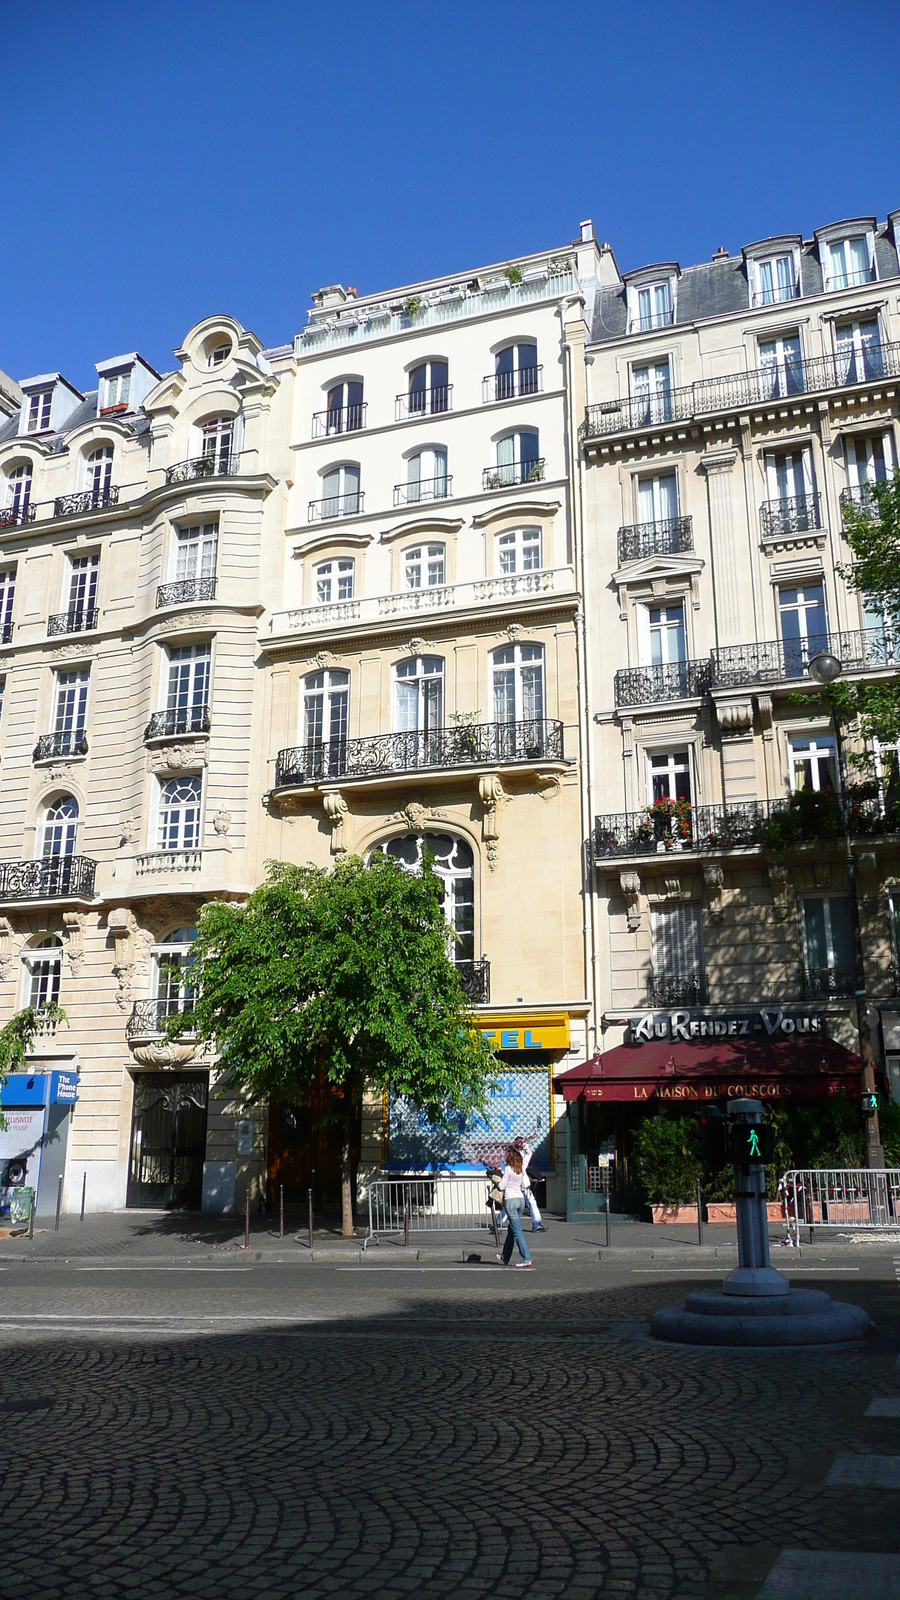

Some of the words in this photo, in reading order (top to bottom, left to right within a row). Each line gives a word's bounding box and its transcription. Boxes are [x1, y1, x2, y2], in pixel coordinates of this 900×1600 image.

[59, 1075, 70, 1083] The
[57, 1083, 77, 1091] Phone
[633, 1086, 649, 1098] LA
[653, 1085, 698, 1098] MAISON
[705, 1085, 721, 1097] DU
[727, 1084, 792, 1097] COUSCOUS
[57, 1090, 76, 1098] House
